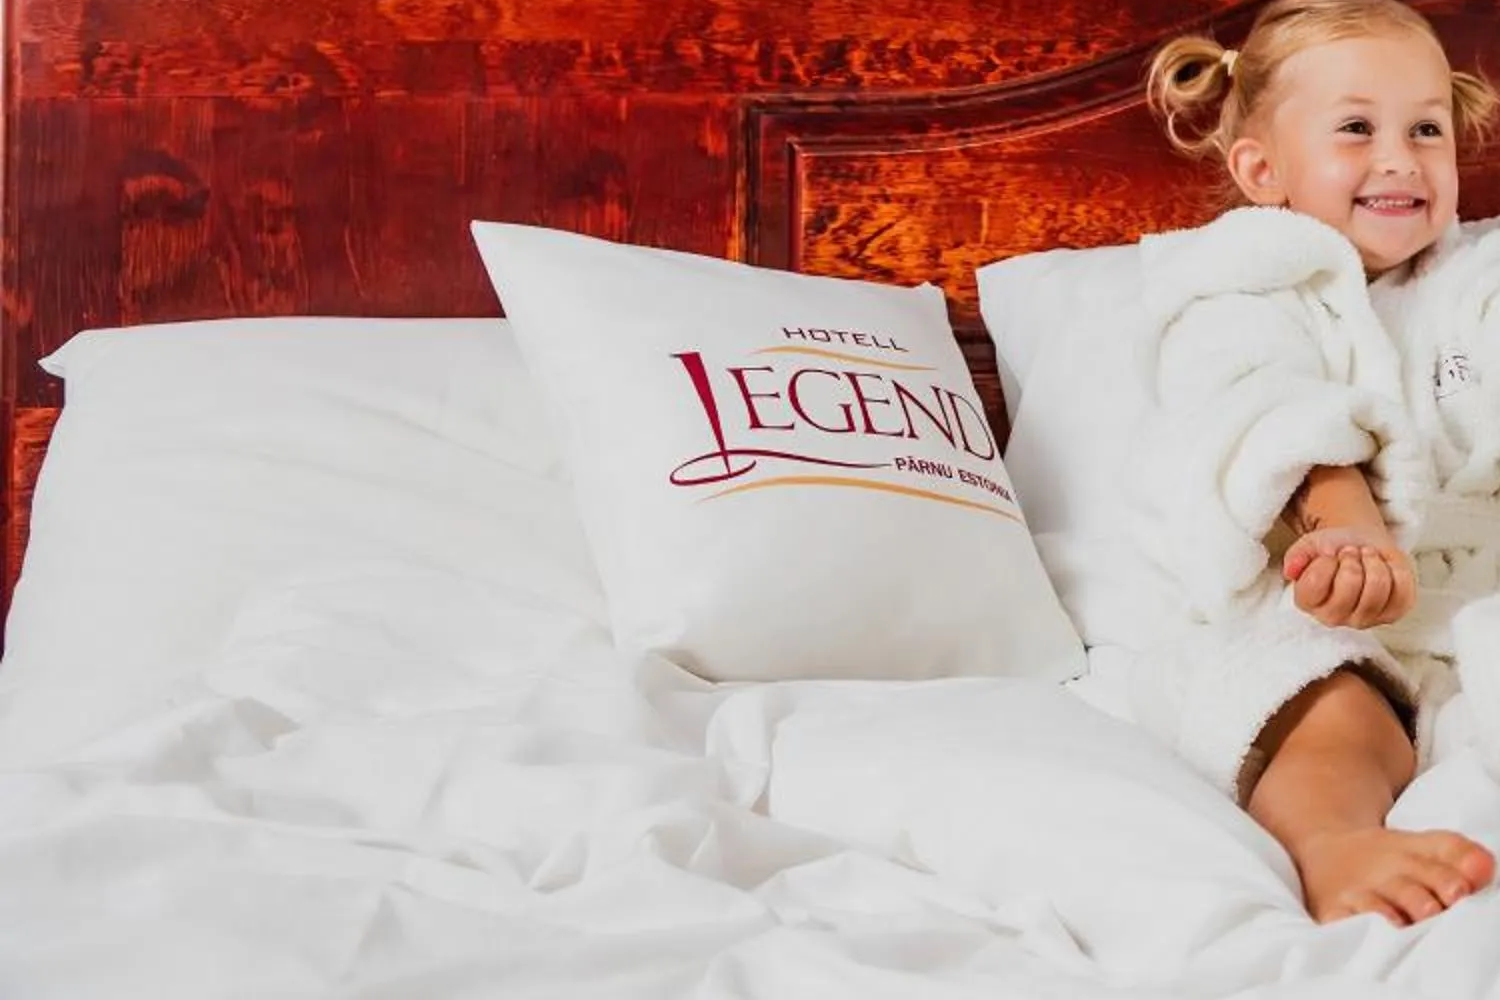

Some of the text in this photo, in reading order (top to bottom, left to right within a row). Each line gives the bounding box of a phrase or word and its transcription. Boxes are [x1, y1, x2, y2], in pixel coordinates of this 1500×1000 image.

[781, 326, 910, 353] HOTELL
[669, 351, 996, 486] LEGEND
[895, 456, 1014, 504] PÄRNU ESTONIA
